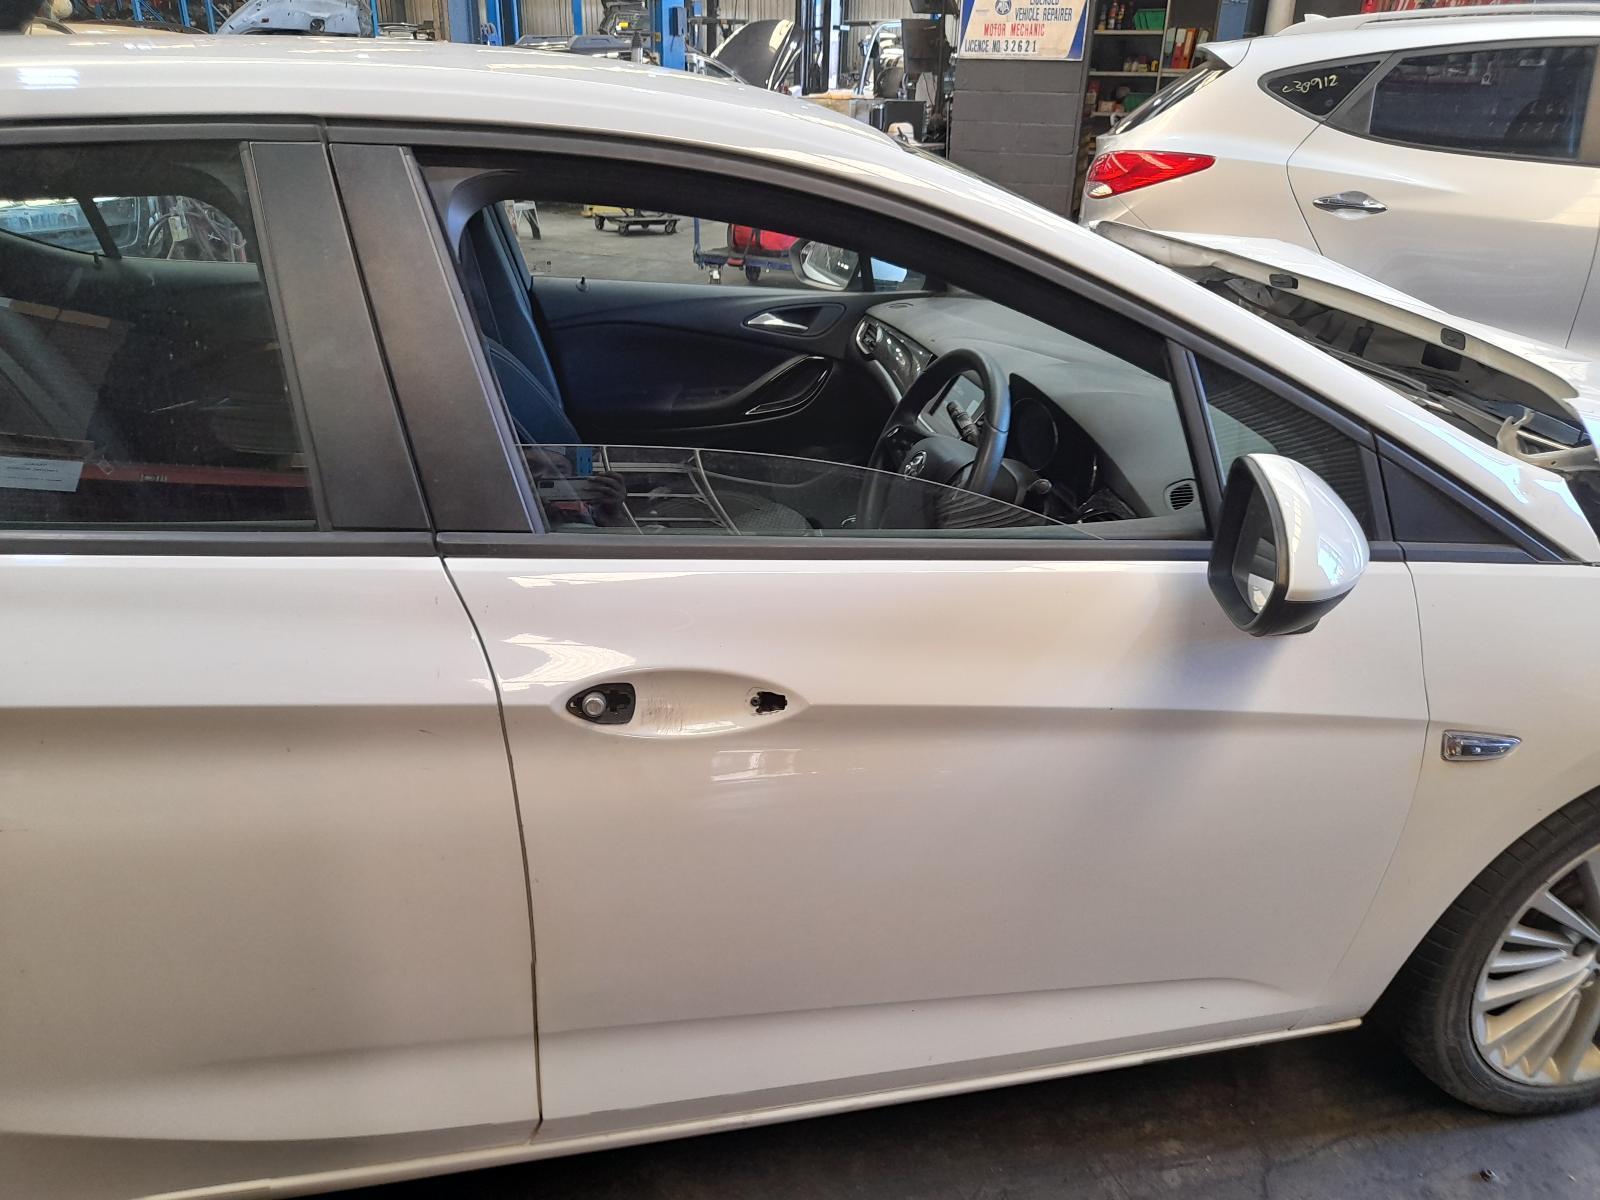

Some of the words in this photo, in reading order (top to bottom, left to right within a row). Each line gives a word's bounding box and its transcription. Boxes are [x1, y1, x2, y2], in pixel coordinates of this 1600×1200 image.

[1015, 8, 1039, 21] VEHICLE
[1042, 8, 1072, 21] REPAIRER
[984, 23, 1006, 36] MOTOR
[1010, 23, 1045, 36] MECHANIC
[964, 40, 989, 53] LICENCE
[1003, 40, 1037, 53] 32621
